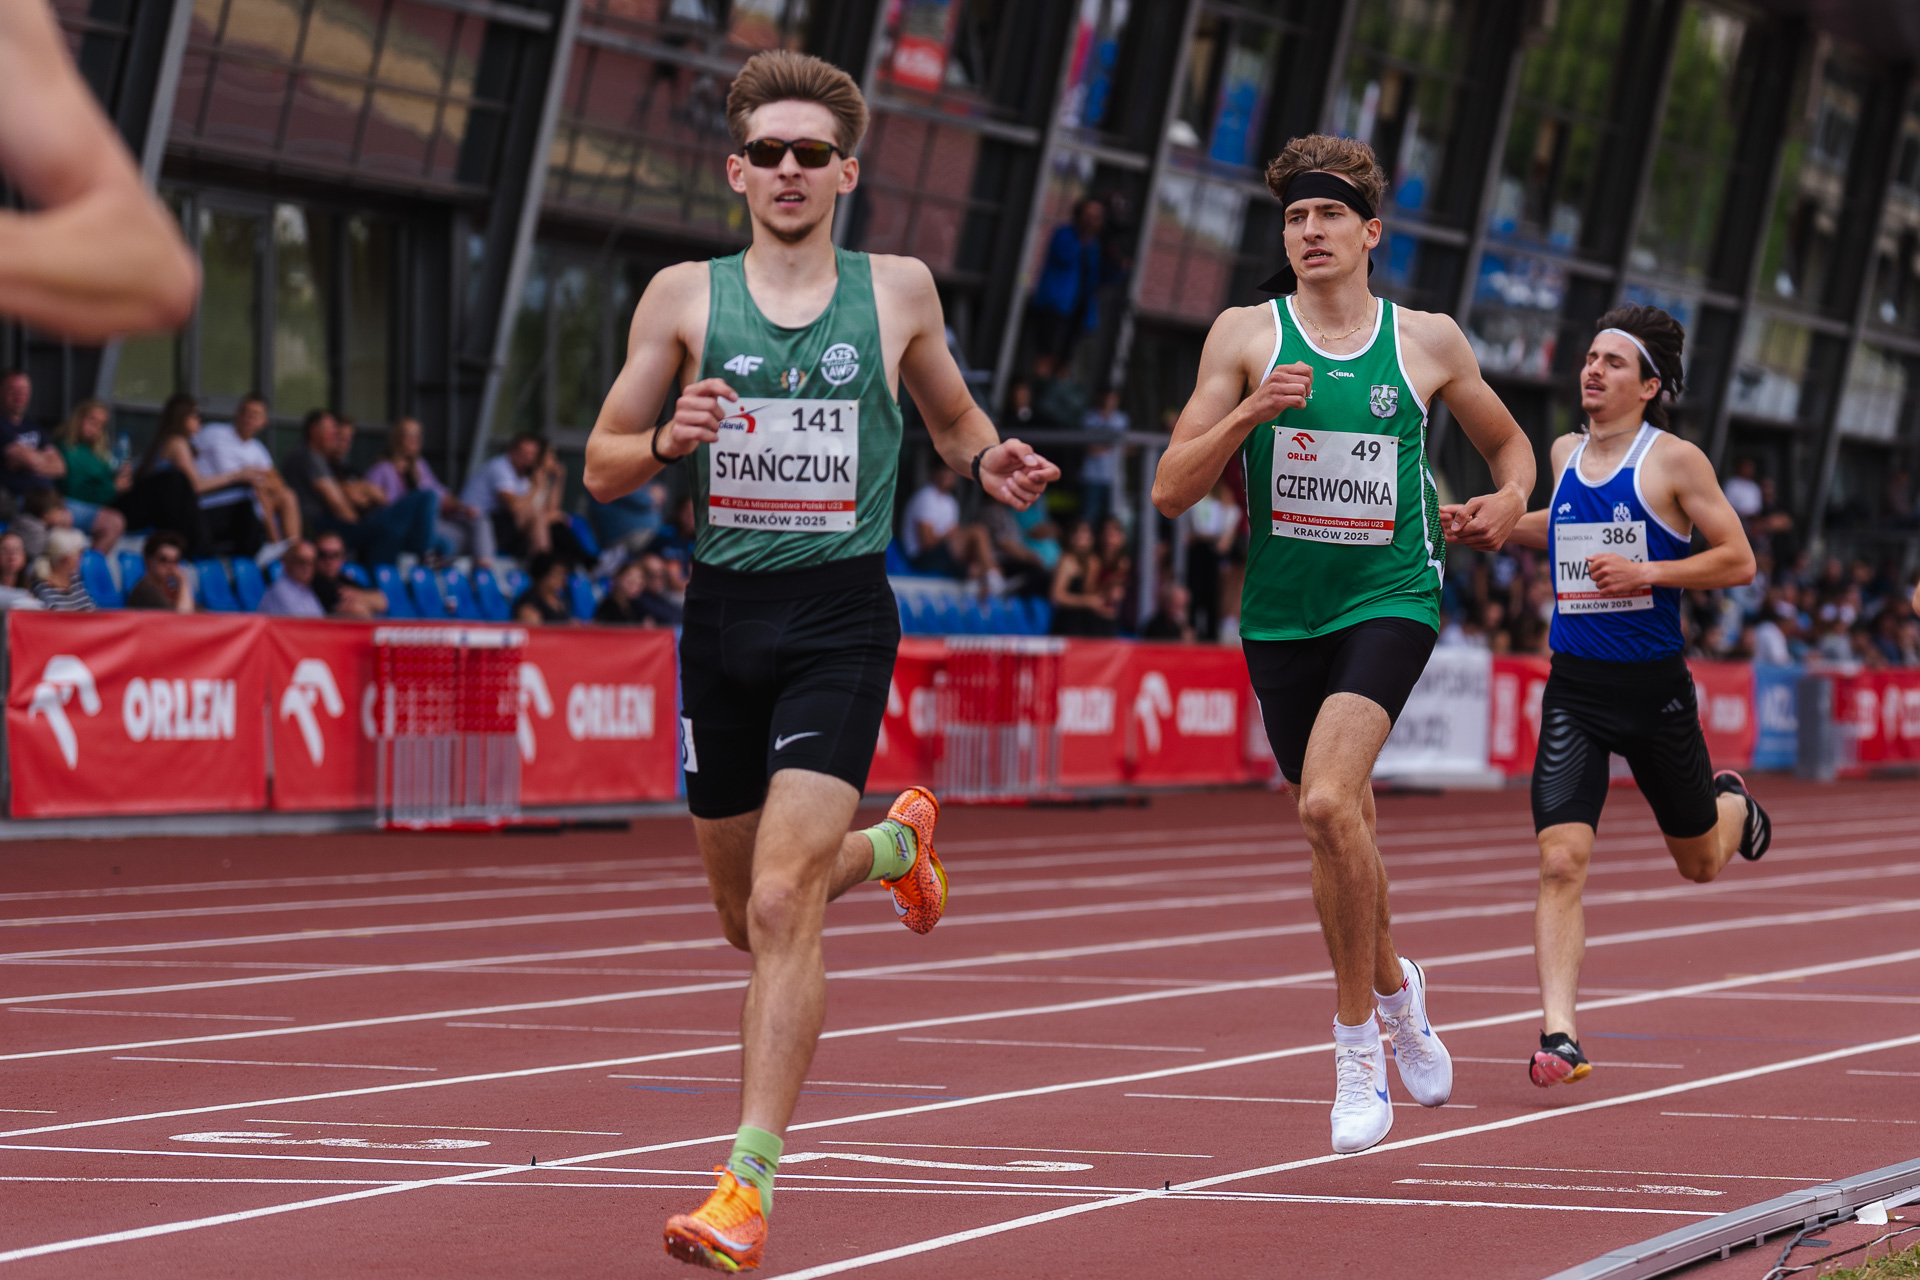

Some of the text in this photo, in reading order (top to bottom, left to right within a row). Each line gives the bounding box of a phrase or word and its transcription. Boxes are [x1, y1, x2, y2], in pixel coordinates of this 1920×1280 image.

[723, 354, 764, 377] 4F
[791, 407, 844, 432] 141
[1287, 451, 1318, 462] ORLEN
[1351, 440, 1382, 462] 49
[715, 447, 850, 483] STAŃCZUK
[1276, 474, 1393, 506] CZERWONKA
[801, 501, 826, 510] Polski
[733, 512, 827, 526] KRAKÓW 2025
[1282, 513, 1384, 528] 42. PZLA Mistrzostwa Polski U23
[1293, 527, 1370, 541] KRAKÓW 2025
[1601, 527, 1637, 545] 386
[1570, 601, 1609, 611] KRAKÓW
[122, 676, 236, 742] ORLEN
[566, 682, 656, 741] ORLEN
